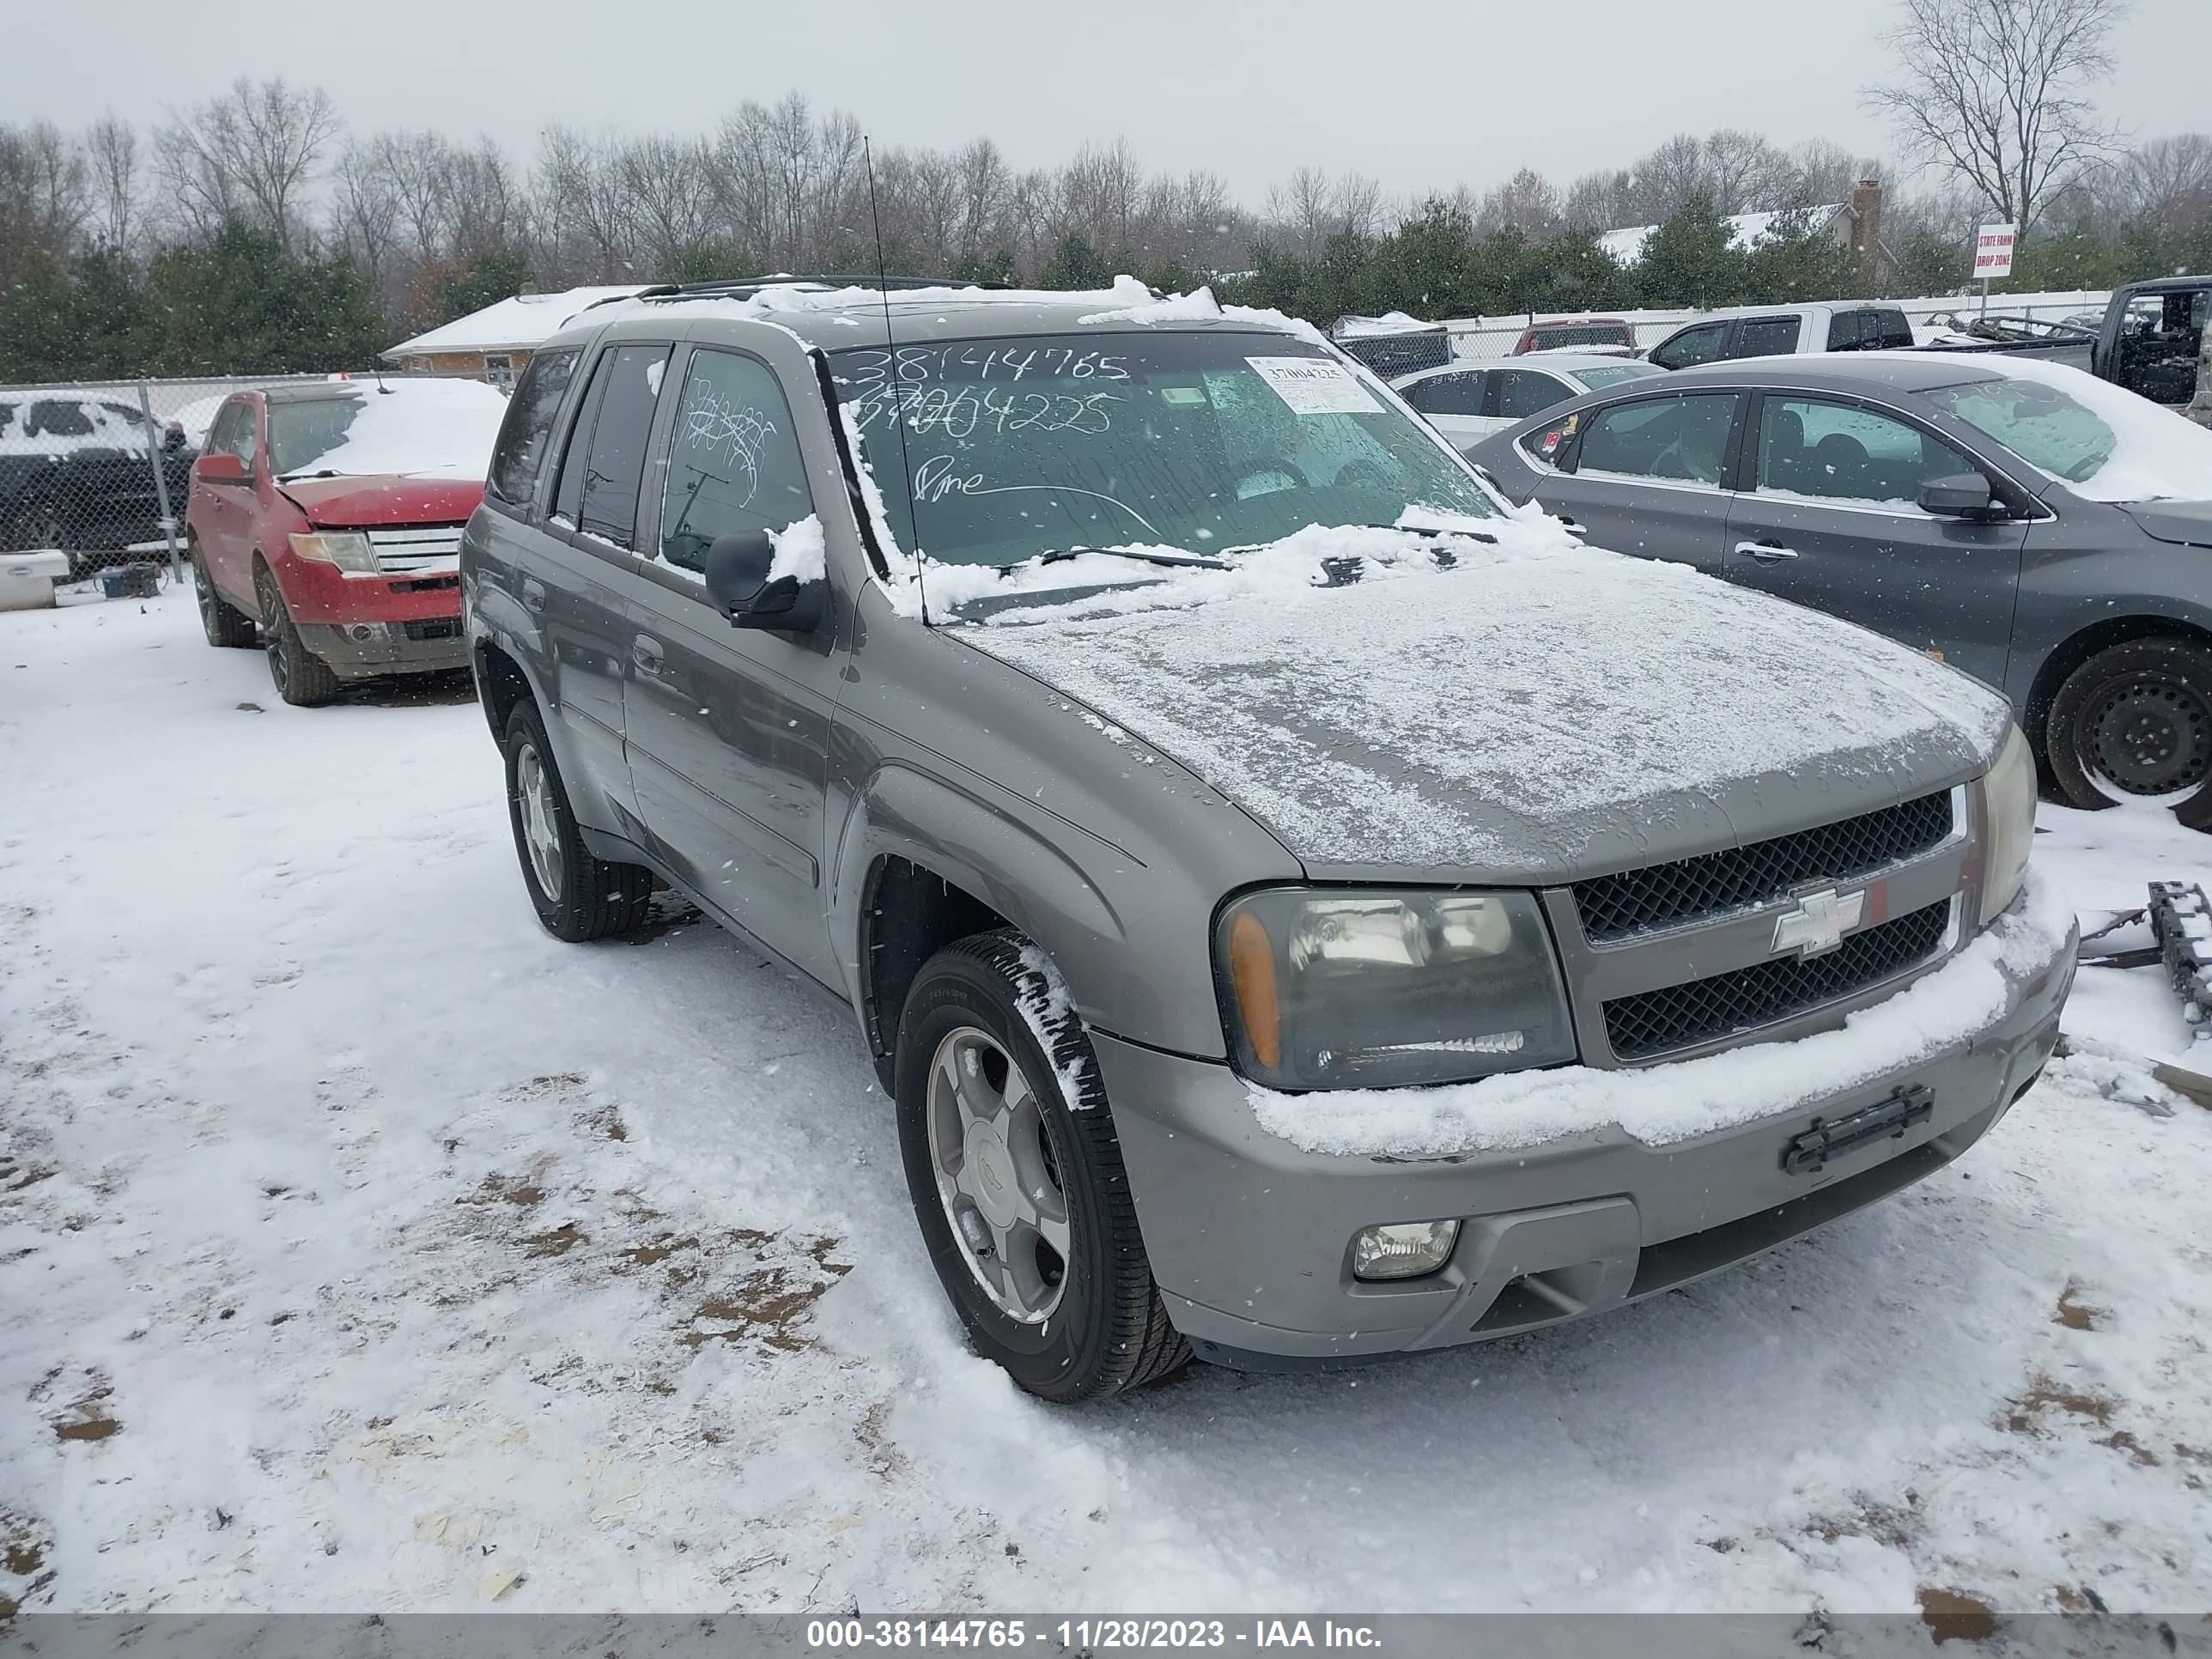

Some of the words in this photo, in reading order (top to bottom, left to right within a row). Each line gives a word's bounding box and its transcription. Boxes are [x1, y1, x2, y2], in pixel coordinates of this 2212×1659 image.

[1979, 236, 1996, 247] STATE
[1978, 255, 1994, 267] DROP
[1995, 254, 2011, 265] ZONE
[846, 348, 1131, 382] 38144765
[1267, 369, 1343, 379] 37004225
